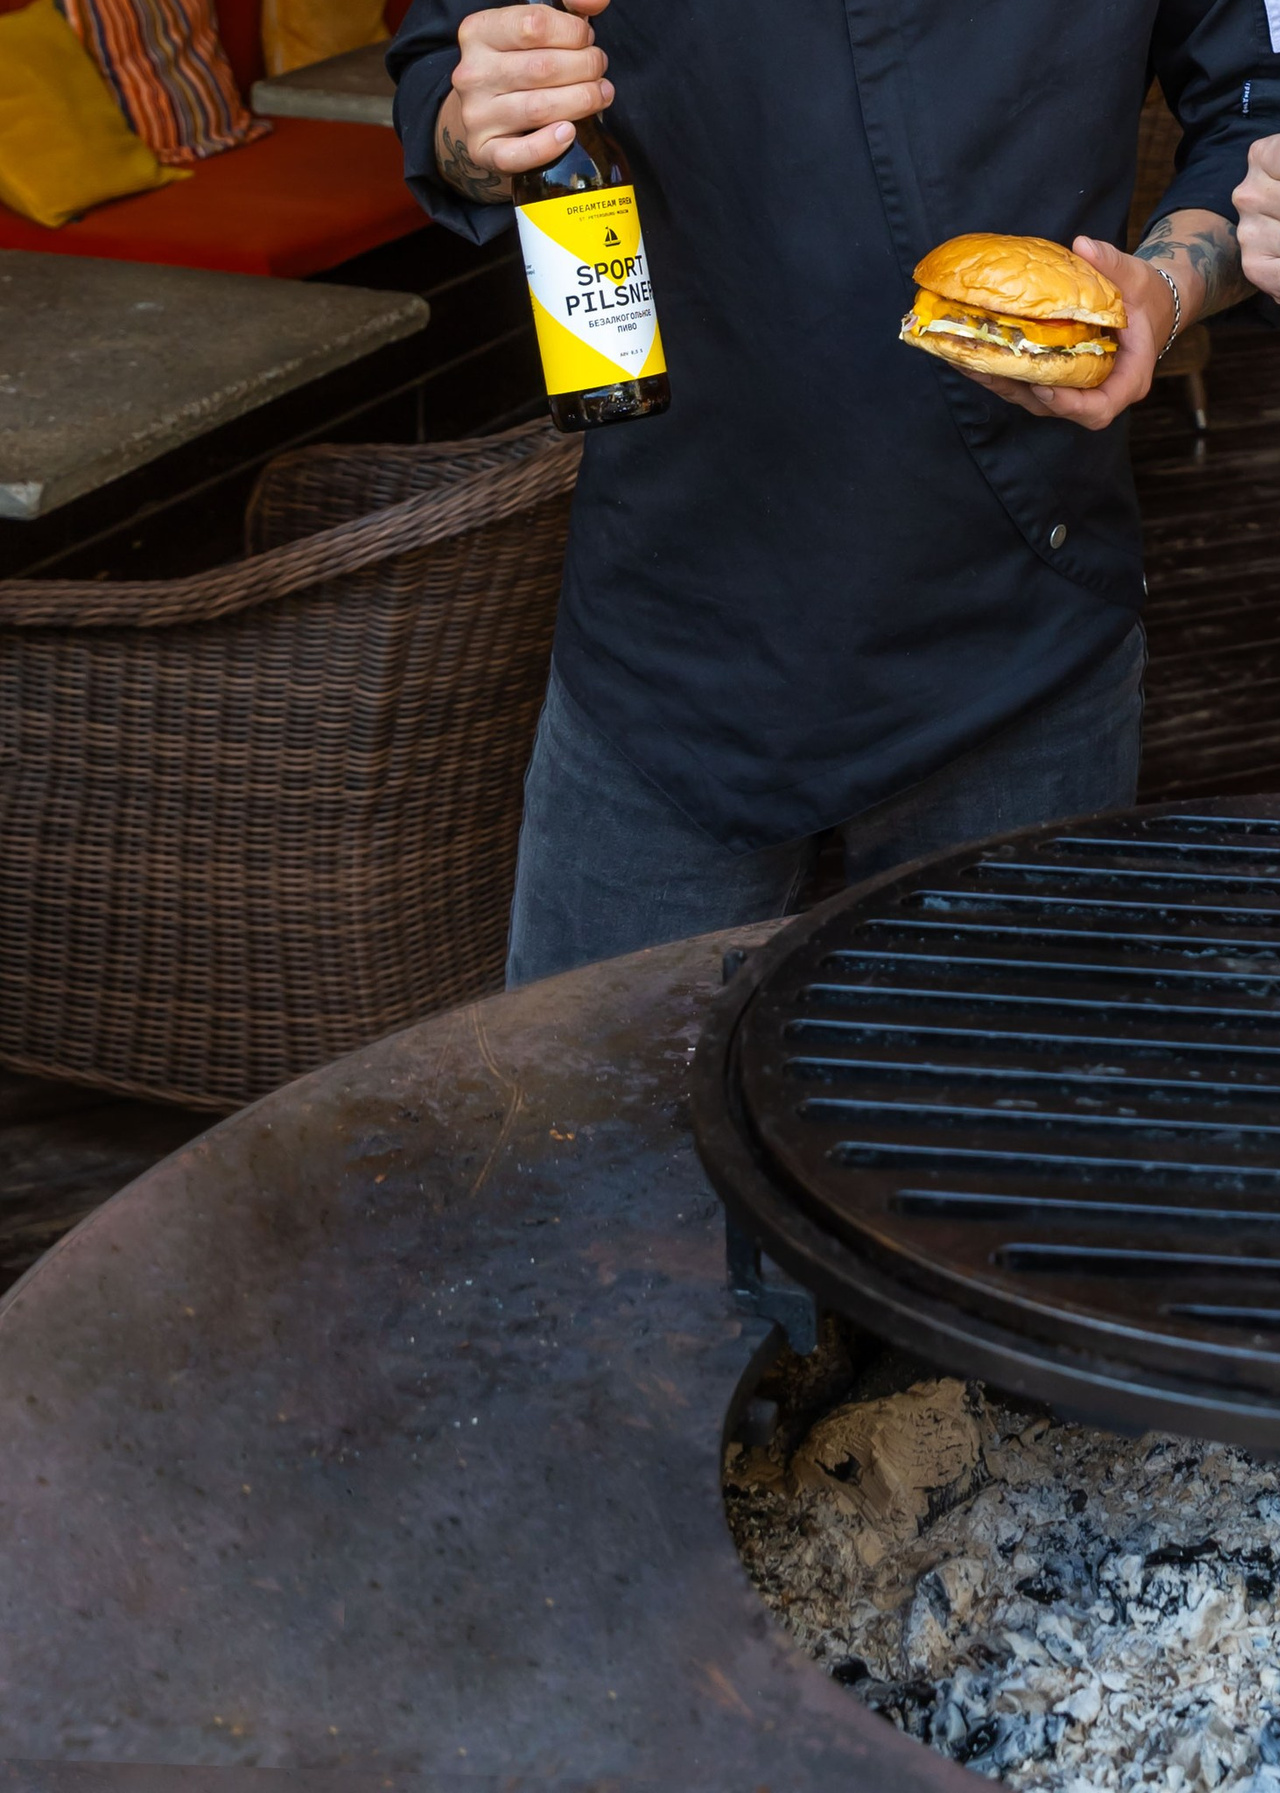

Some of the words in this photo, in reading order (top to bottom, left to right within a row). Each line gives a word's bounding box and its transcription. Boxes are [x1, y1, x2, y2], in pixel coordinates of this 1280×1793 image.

[566, 198, 617, 215] DREAMTEAM
[576, 255, 643, 286] SPORT
[588, 308, 652, 328] БЕЗАЛКОГОЛЬНОЕ
[617, 322, 638, 333] ПИВО
